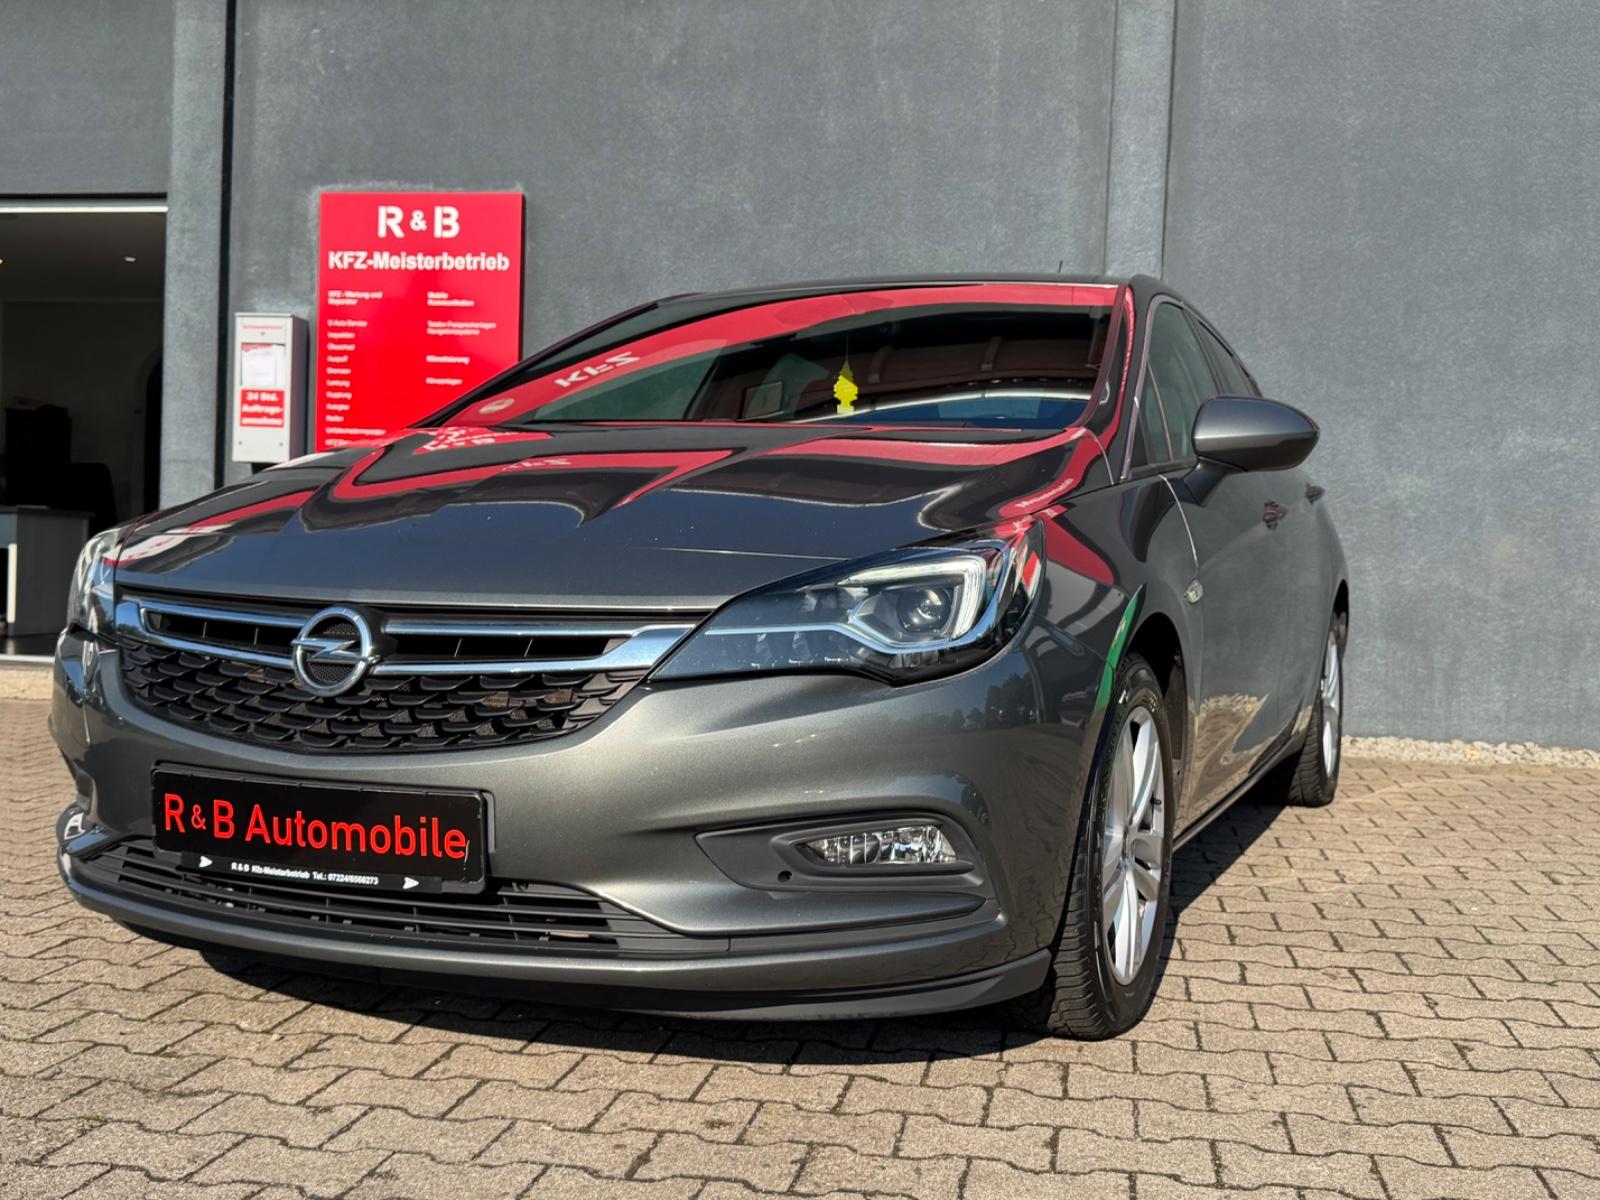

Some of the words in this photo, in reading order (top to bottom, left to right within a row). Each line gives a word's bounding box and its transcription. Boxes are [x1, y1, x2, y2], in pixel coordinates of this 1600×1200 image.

[377, 206, 405, 238] R
[410, 210, 427, 231] &
[434, 206, 460, 238] B
[328, 251, 510, 271] KFZ-Meisterbetrieb
[164, 793, 185, 833] R
[191, 804, 207, 831] &
[213, 799, 235, 839] B
[245, 804, 467, 859] Automobile
